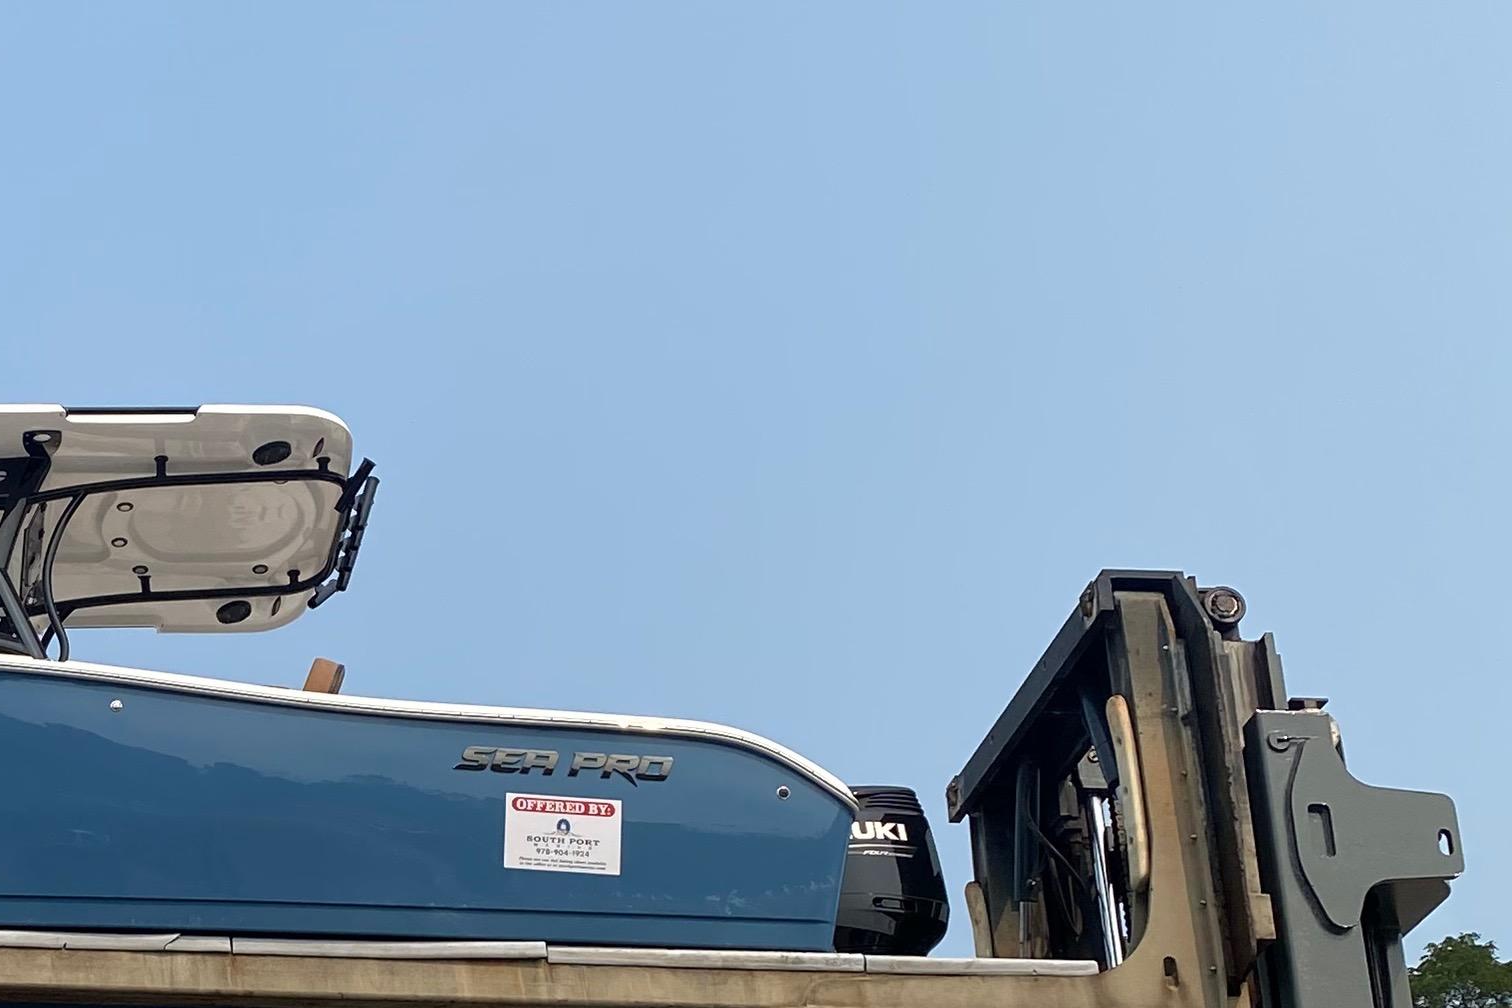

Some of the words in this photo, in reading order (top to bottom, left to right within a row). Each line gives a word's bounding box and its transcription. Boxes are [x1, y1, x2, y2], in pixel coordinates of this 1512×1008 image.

[453, 745, 559, 776] SEA
[568, 752, 675, 787] PRO
[516, 798, 586, 814] OFFERED
[588, 803, 612, 816] BY:
[849, 821, 909, 841] UKI
[526, 835, 565, 844] SOUTH
[569, 838, 600, 847] PORT
